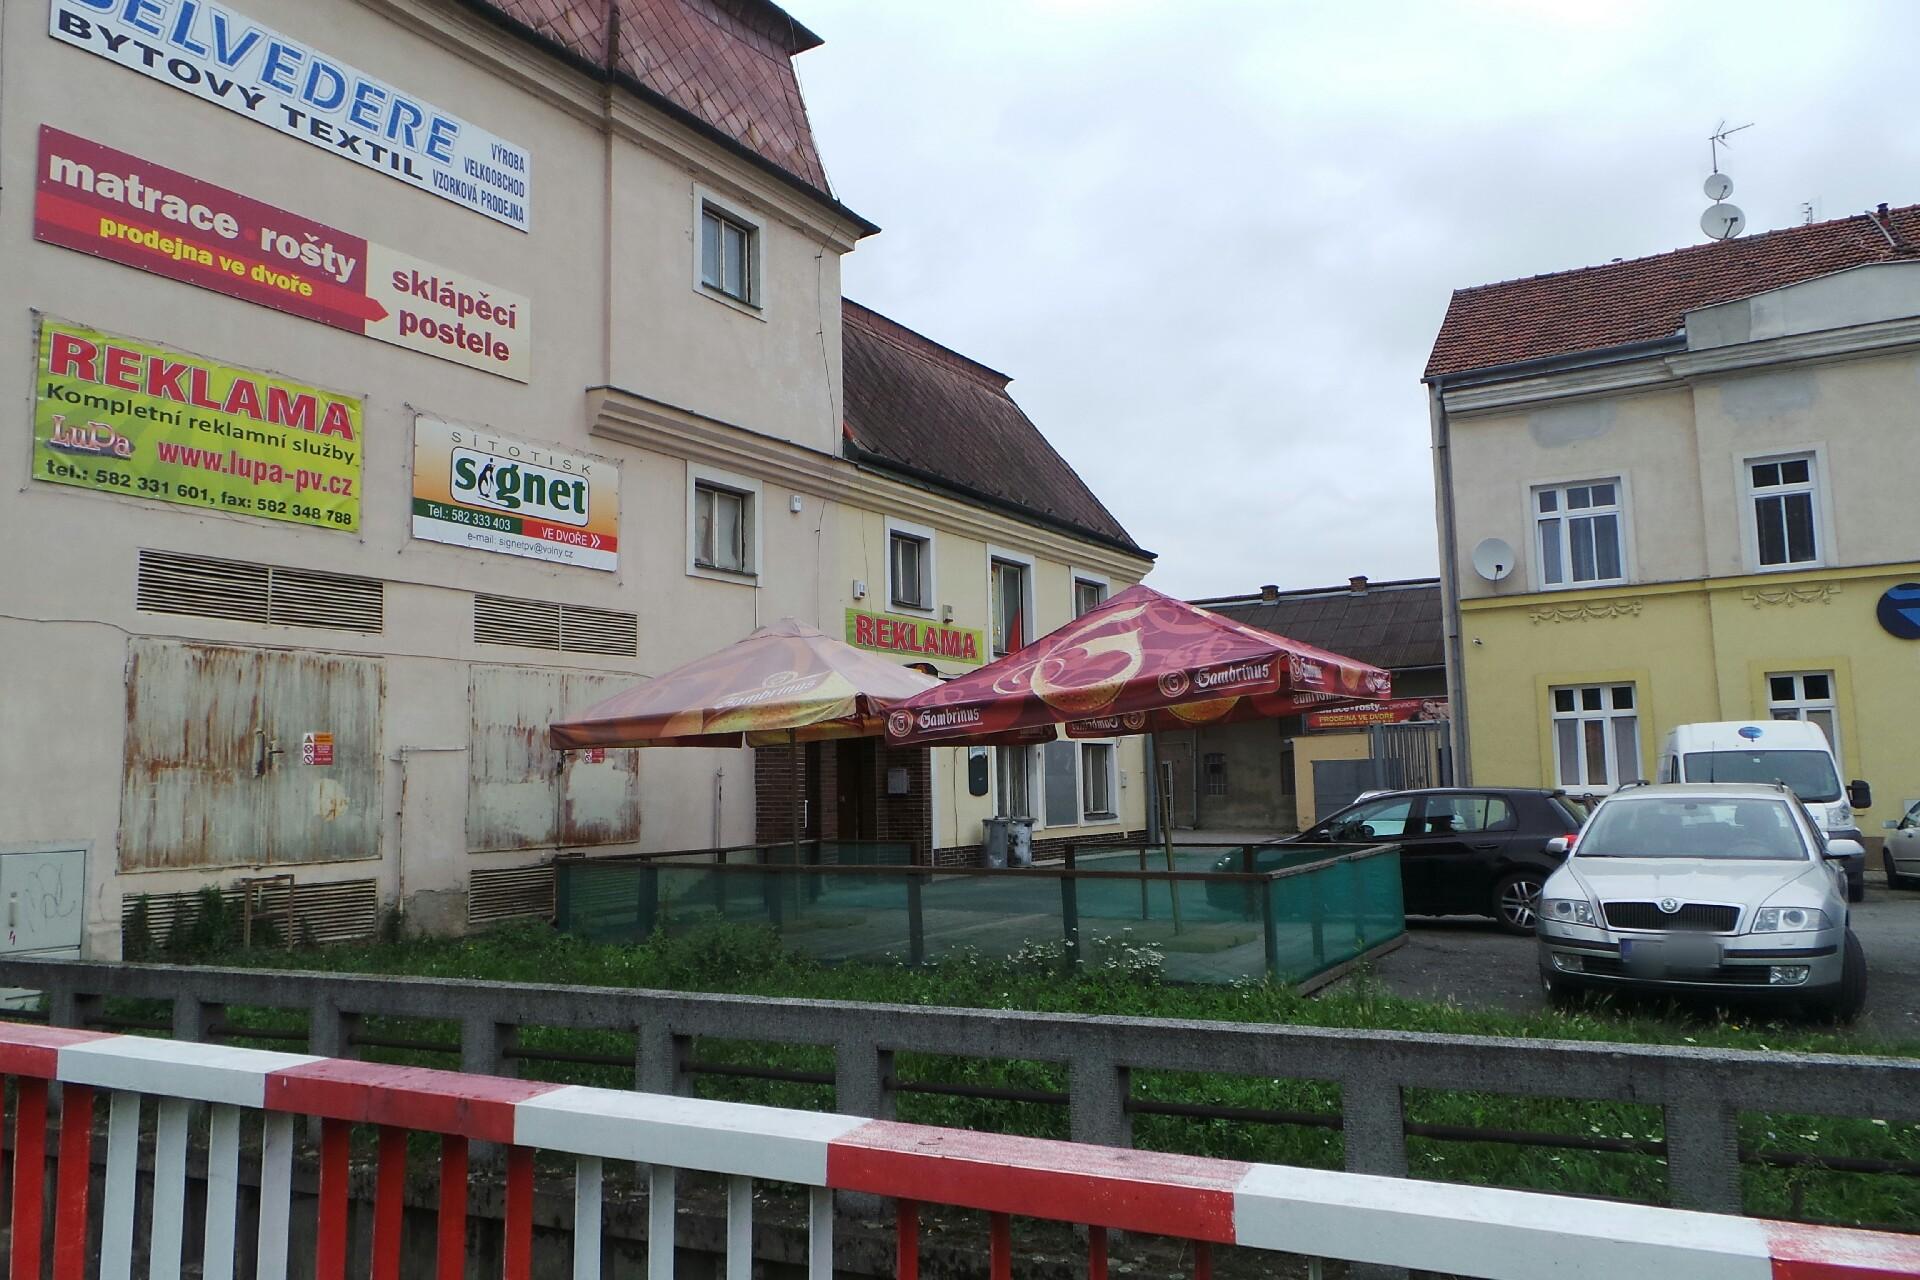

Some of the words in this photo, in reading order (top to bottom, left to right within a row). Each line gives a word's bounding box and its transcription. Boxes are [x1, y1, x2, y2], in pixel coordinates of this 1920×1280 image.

[58, 10, 266, 112] BYTOVÝ
[280, 103, 424, 181] TEXTIL
[79, 0, 461, 165] ELVEDERE
[464, 157, 525, 198] VELKOOBCHOD
[491, 143, 525, 173] VÝROBA
[49, 152, 240, 241] matrace
[260, 232, 356, 284] rošty
[433, 168, 477, 204] VZORKOVÁ
[481, 190, 524, 223] PRODEJNA
[99, 217, 214, 266] prodejna
[218, 251, 246, 277] ve
[251, 263, 313, 299] dvoře
[392, 270, 516, 329] sklápěcí
[400, 309, 510, 361] postele
[49, 331, 356, 441] REKLAMA
[47, 383, 181, 427] Kompletní
[189, 416, 287, 448] reklamní
[292, 437, 355, 465] služby
[46, 459, 88, 480] tel.:
[96, 469, 131, 488] 582
[137, 477, 169, 494] 331
[177, 484, 215, 504] 601,
[221, 491, 252, 508] fax:
[257, 498, 287, 514] 582
[292, 504, 321, 520] 348
[326, 509, 352, 525] 788
[157, 440, 353, 497] www.lupa-pv.cz
[427, 503, 450, 520] Tel.:
[451, 508, 471, 525] 582
[472, 513, 491, 528] 333
[493, 516, 511, 532] 403
[541, 526, 554, 540] VE
[556, 529, 588, 546] DVOŘE
[854, 614, 977, 659] REKLAMA
[1194, 663, 1270, 688] Gambrinus
[919, 708, 980, 729] Gambrinus
